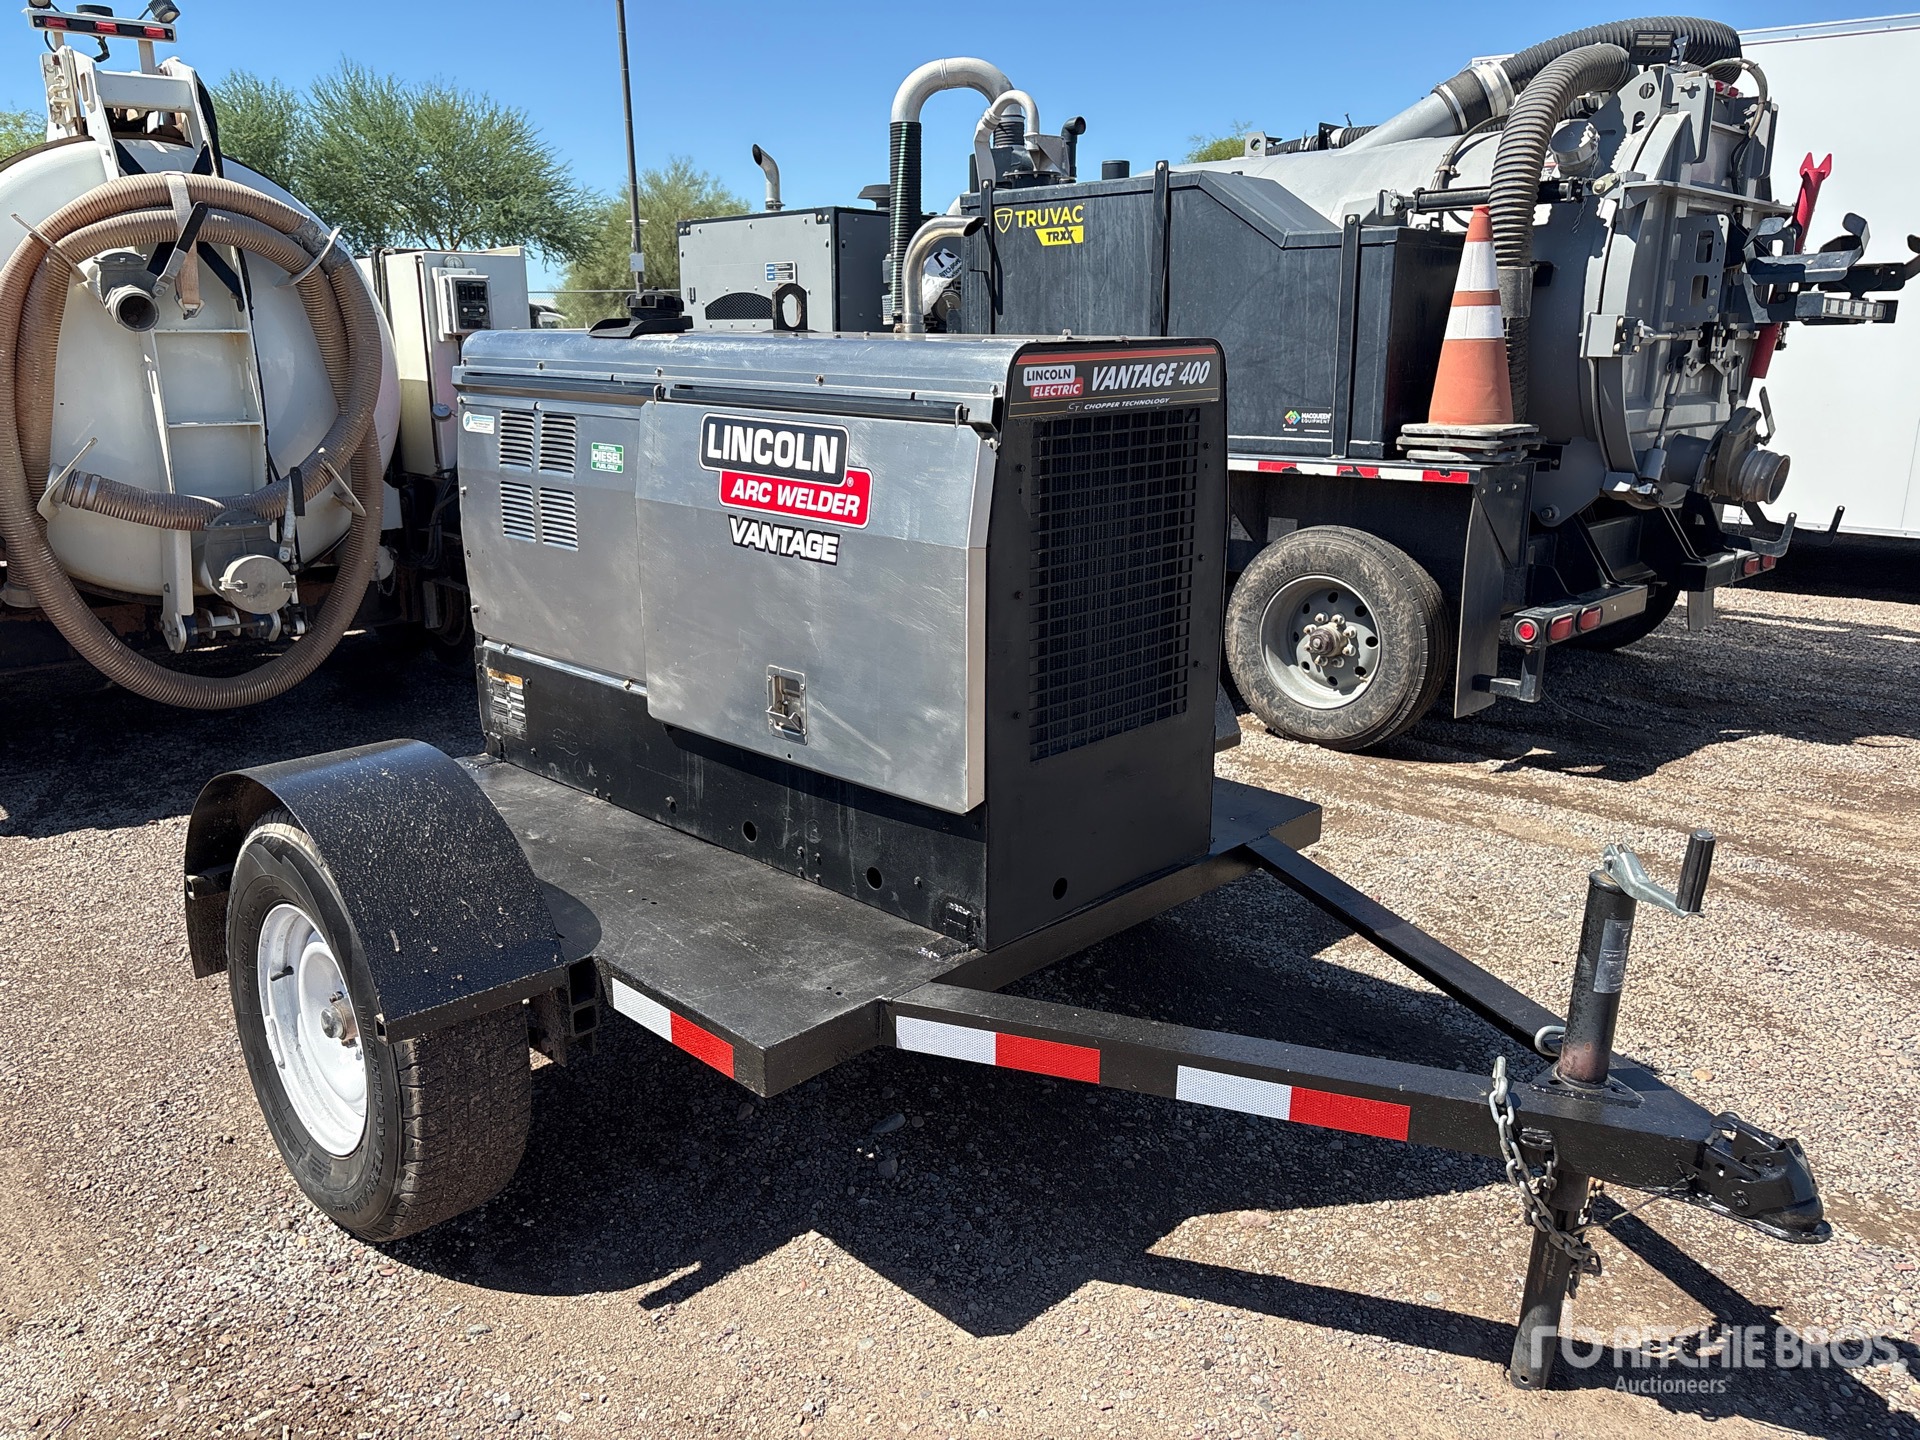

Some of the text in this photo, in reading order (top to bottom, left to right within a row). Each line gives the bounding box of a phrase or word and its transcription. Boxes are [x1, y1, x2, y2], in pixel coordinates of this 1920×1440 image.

[1015, 205, 1083, 228] TRUVAC
[1046, 230, 1073, 242] TRXX
[1026, 360, 1211, 391] LINCOLN VANTAGE 400
[1033, 384, 1081, 397] ELECTRIC
[1084, 401, 1120, 410] CHOPPER
[1121, 398, 1170, 408] TECHNOLOGY
[592, 450, 622, 464] DIESEL
[707, 423, 838, 474] LINCOLN
[730, 478, 860, 518] ARC WELDER
[729, 515, 839, 564] VANTAGE
